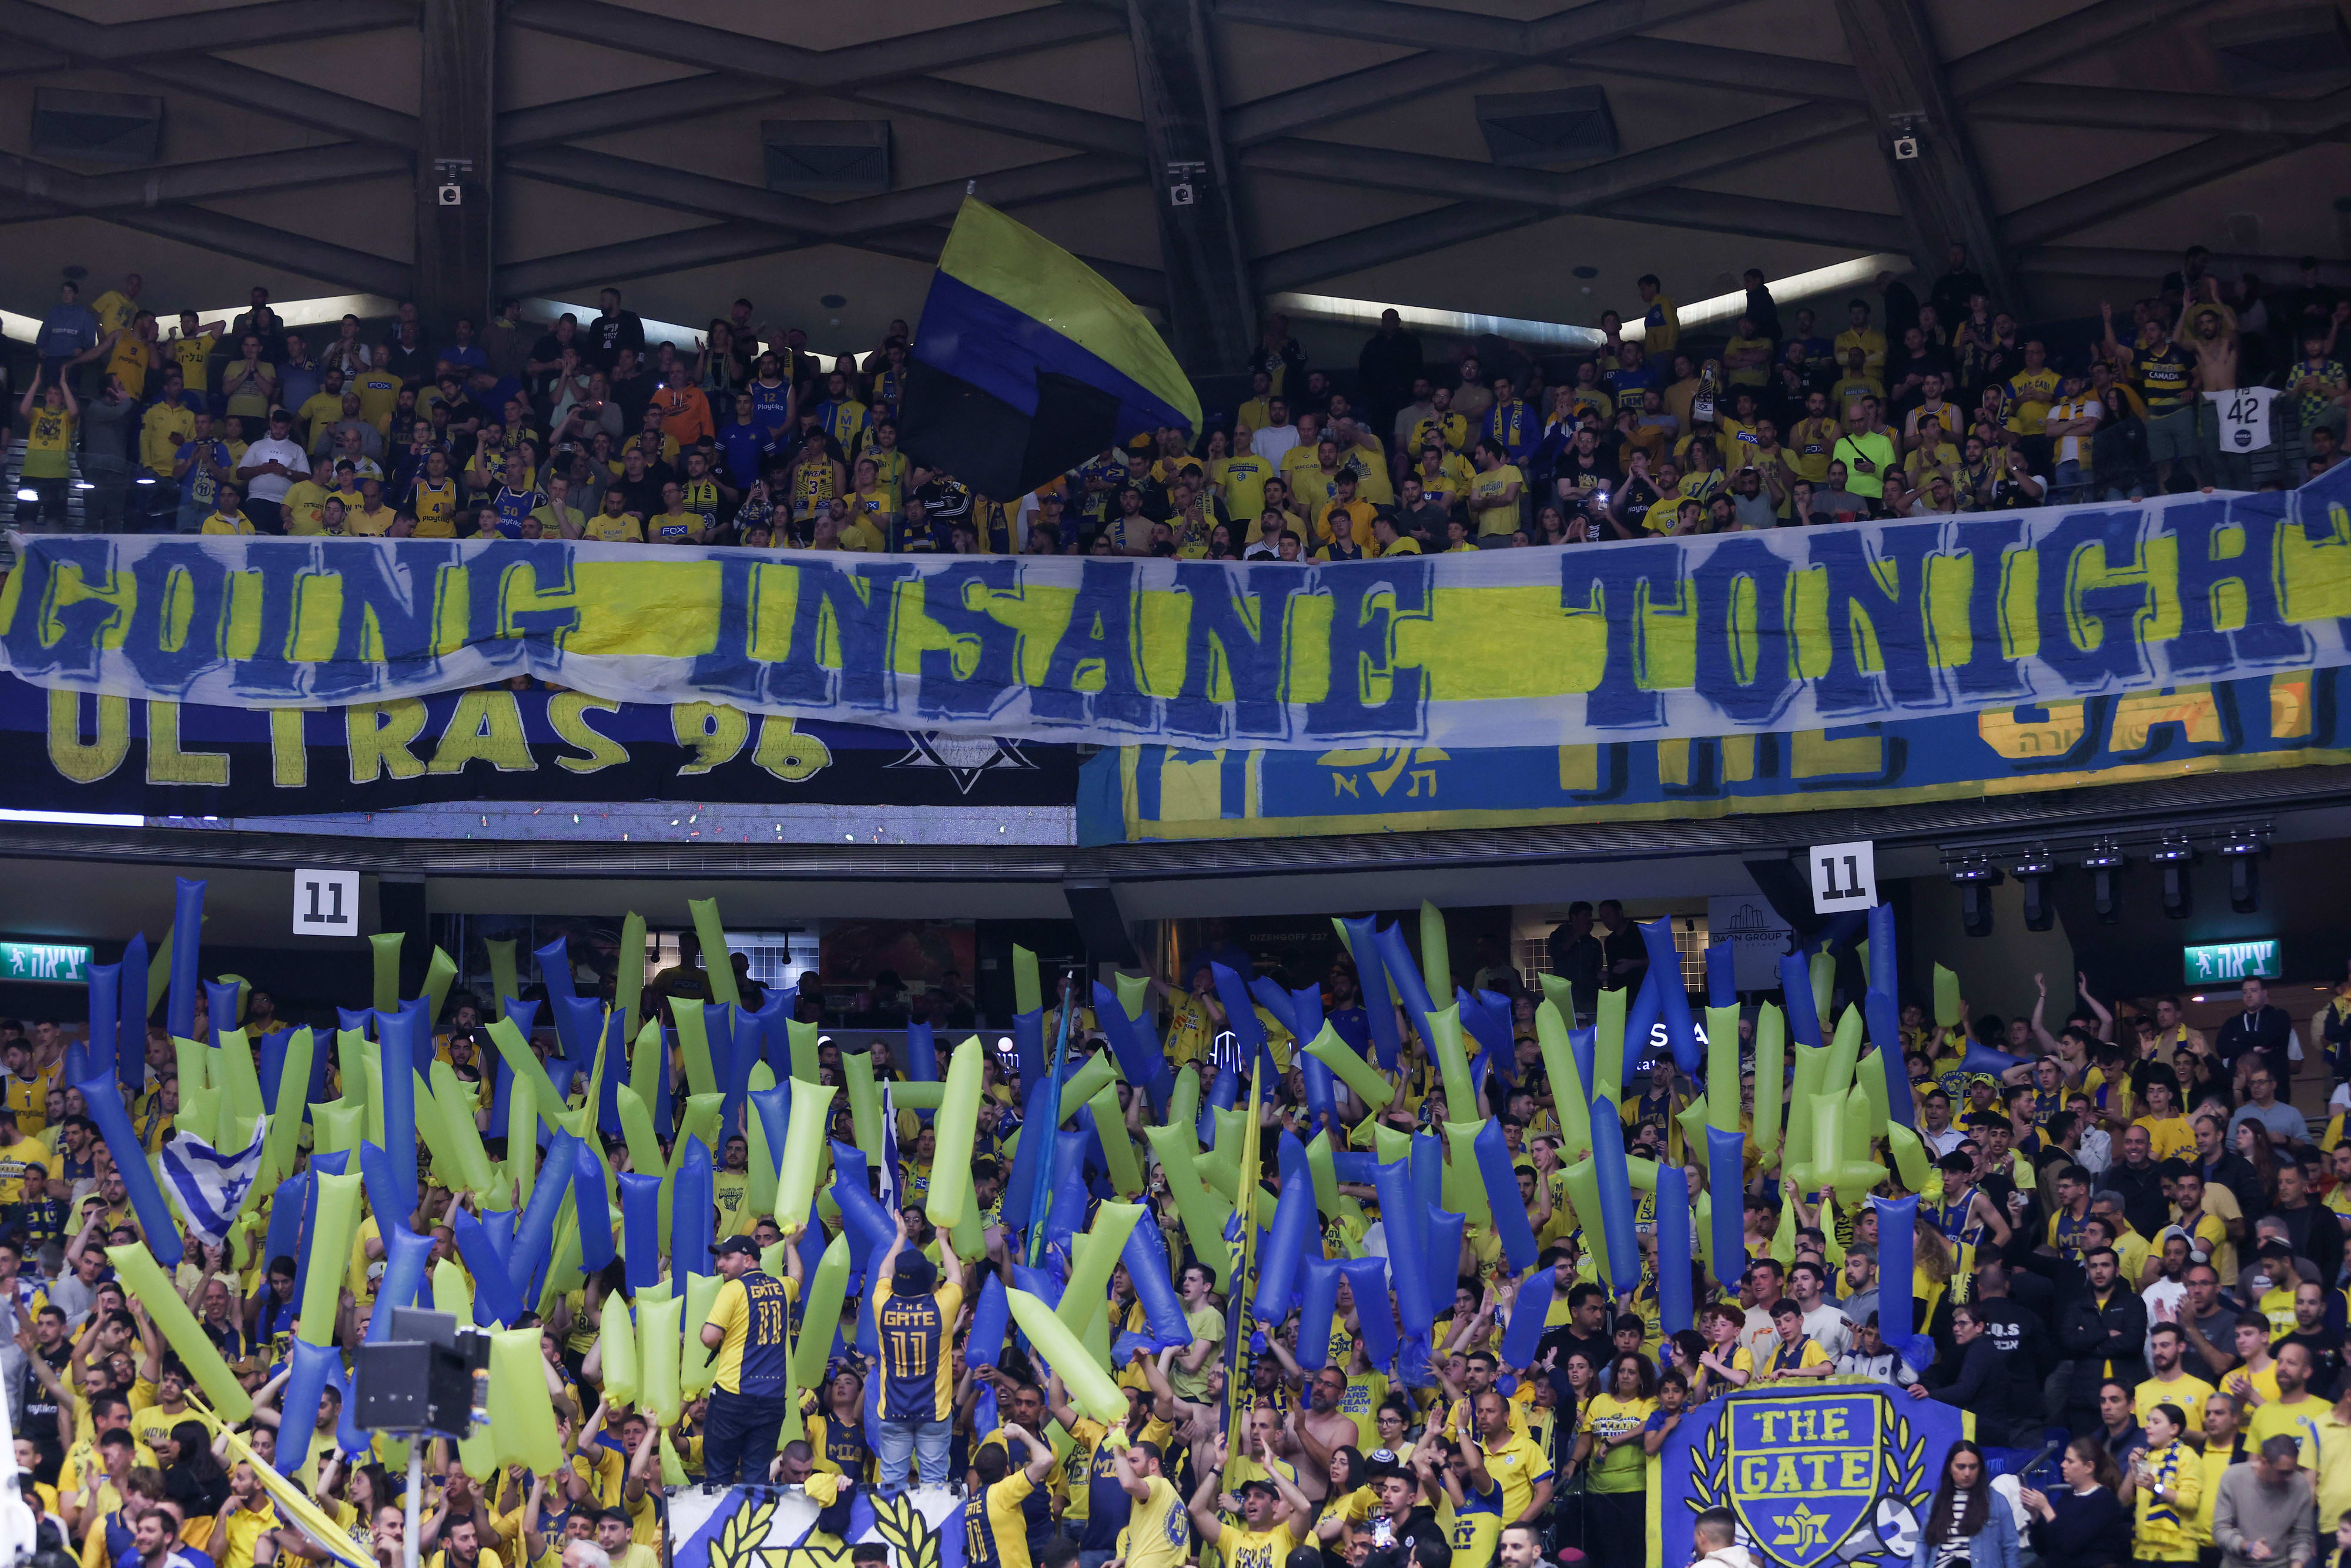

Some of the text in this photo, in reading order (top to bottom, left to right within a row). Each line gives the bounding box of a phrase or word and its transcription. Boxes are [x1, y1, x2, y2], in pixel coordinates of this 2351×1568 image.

[2149, 371, 2178, 380] CANADA
[763, 393, 776, 402] 12
[2227, 398, 2259, 424] 42
[1738, 432, 1759, 443] FOX
[1806, 445, 1824, 453] FOX
[808, 481, 818, 495] 3
[1481, 481, 1503, 492] MACCABI
[1636, 493, 1643, 502] 5
[432, 503, 440, 512] 4
[503, 506, 518, 517] 50
[1627, 505, 1649, 513] Playtik
[499, 517, 522, 528] laytika
[662, 526, 685, 535] FOX
[3, 538, 579, 698] GOING
[686, 554, 1434, 742] INSANE
[47, 689, 833, 788] ULTRAS 96
[1821, 855, 1866, 900] 11
[304, 882, 348, 923] 11
[1250, 932, 1328, 942] DIZENGOFF 237
[1745, 932, 1782, 942] GROUP
[32, 947, 86, 979] יציאה
[2218, 943, 2272, 978] יציאה
[25, 1095, 31, 1108] 1
[749, 1284, 783, 1299] GATE
[896, 1302, 923, 1311] THE
[757, 1300, 782, 1345] 11
[883, 1311, 936, 1326] GATE
[890, 1331, 927, 1378] 11
[1753, 1407, 1850, 1443] THE
[828, 1443, 863, 1462] MTA
[1093, 1457, 1118, 1477] MT
[1740, 1450, 1871, 1494] GATE
